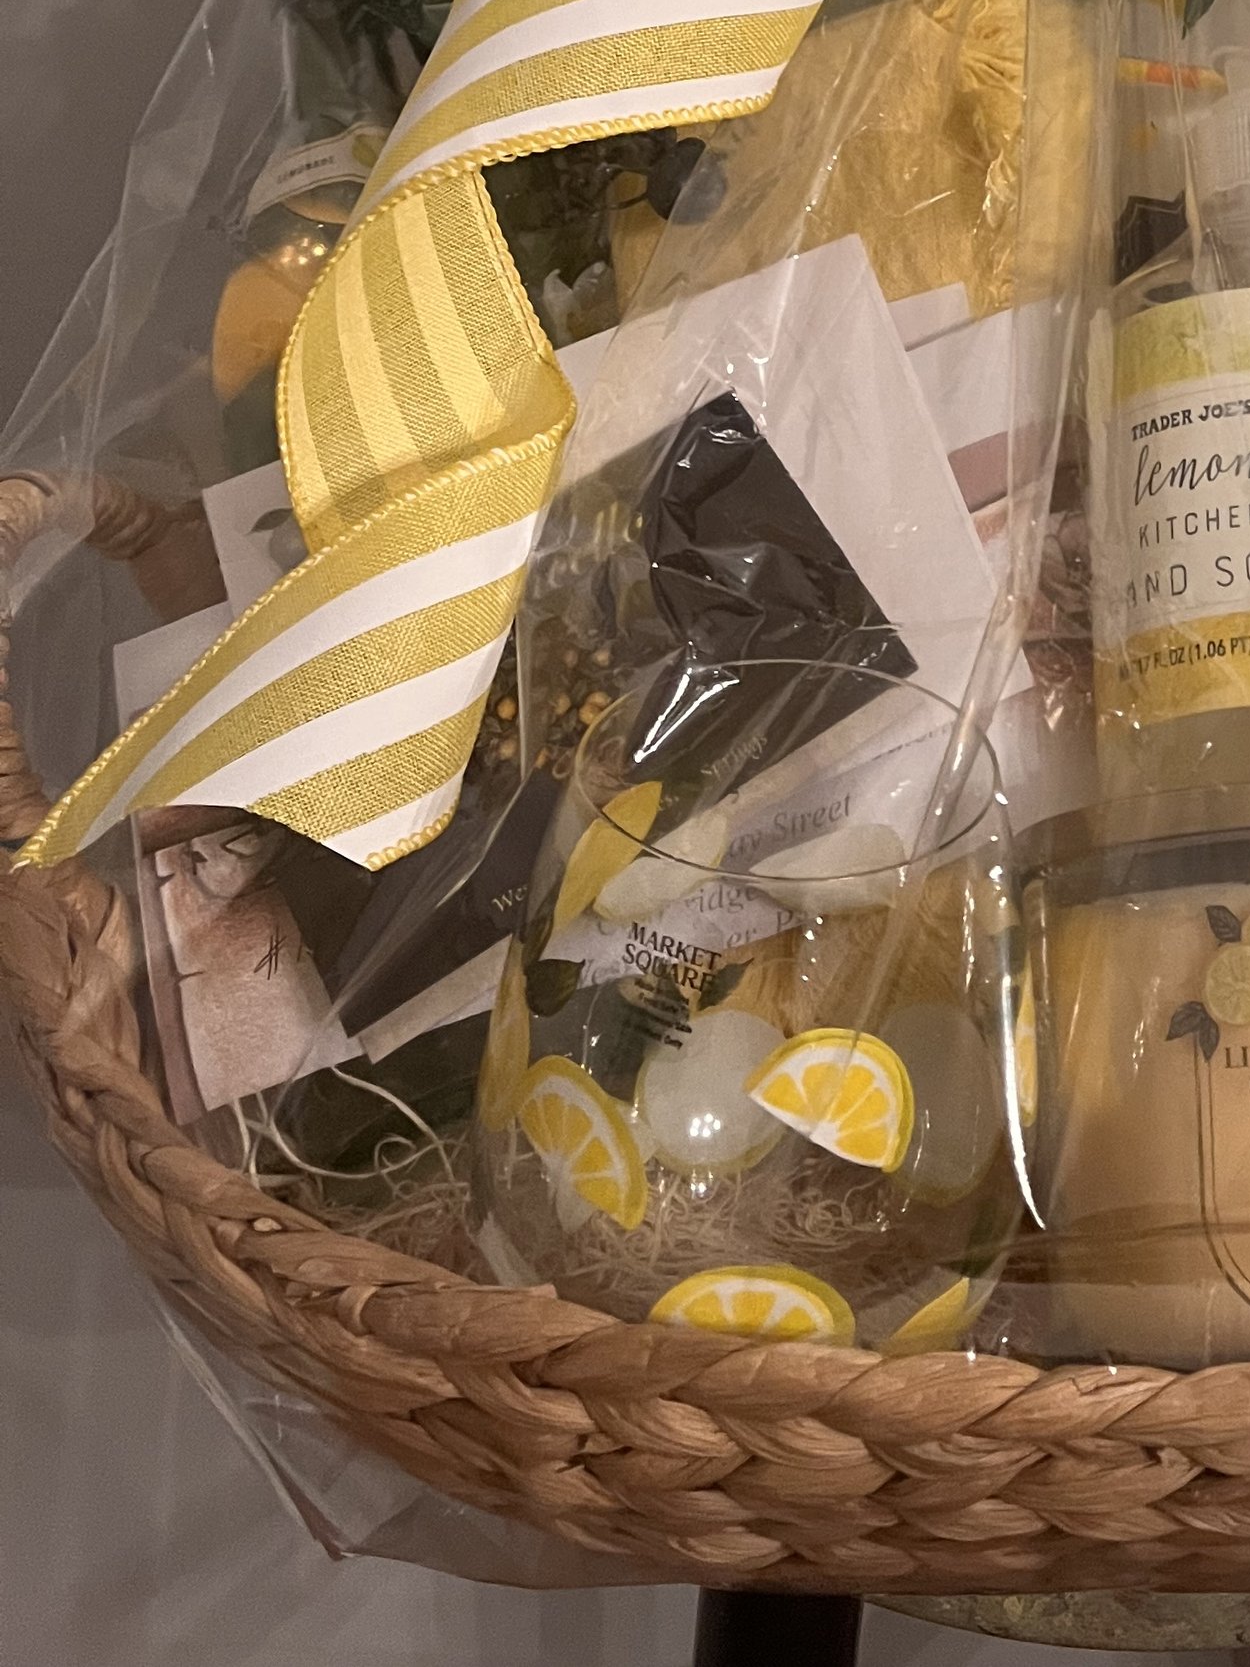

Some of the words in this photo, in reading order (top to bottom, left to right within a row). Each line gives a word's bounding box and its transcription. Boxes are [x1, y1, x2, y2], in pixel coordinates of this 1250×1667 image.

[1132, 408, 1192, 441] TRADER
[1126, 563, 1188, 608] AND
[1188, 639, 1226, 665] (1.06
[772, 792, 852, 836] Street
[621, 942, 716, 993] SQUARE
[628, 920, 722, 971] MARKET
